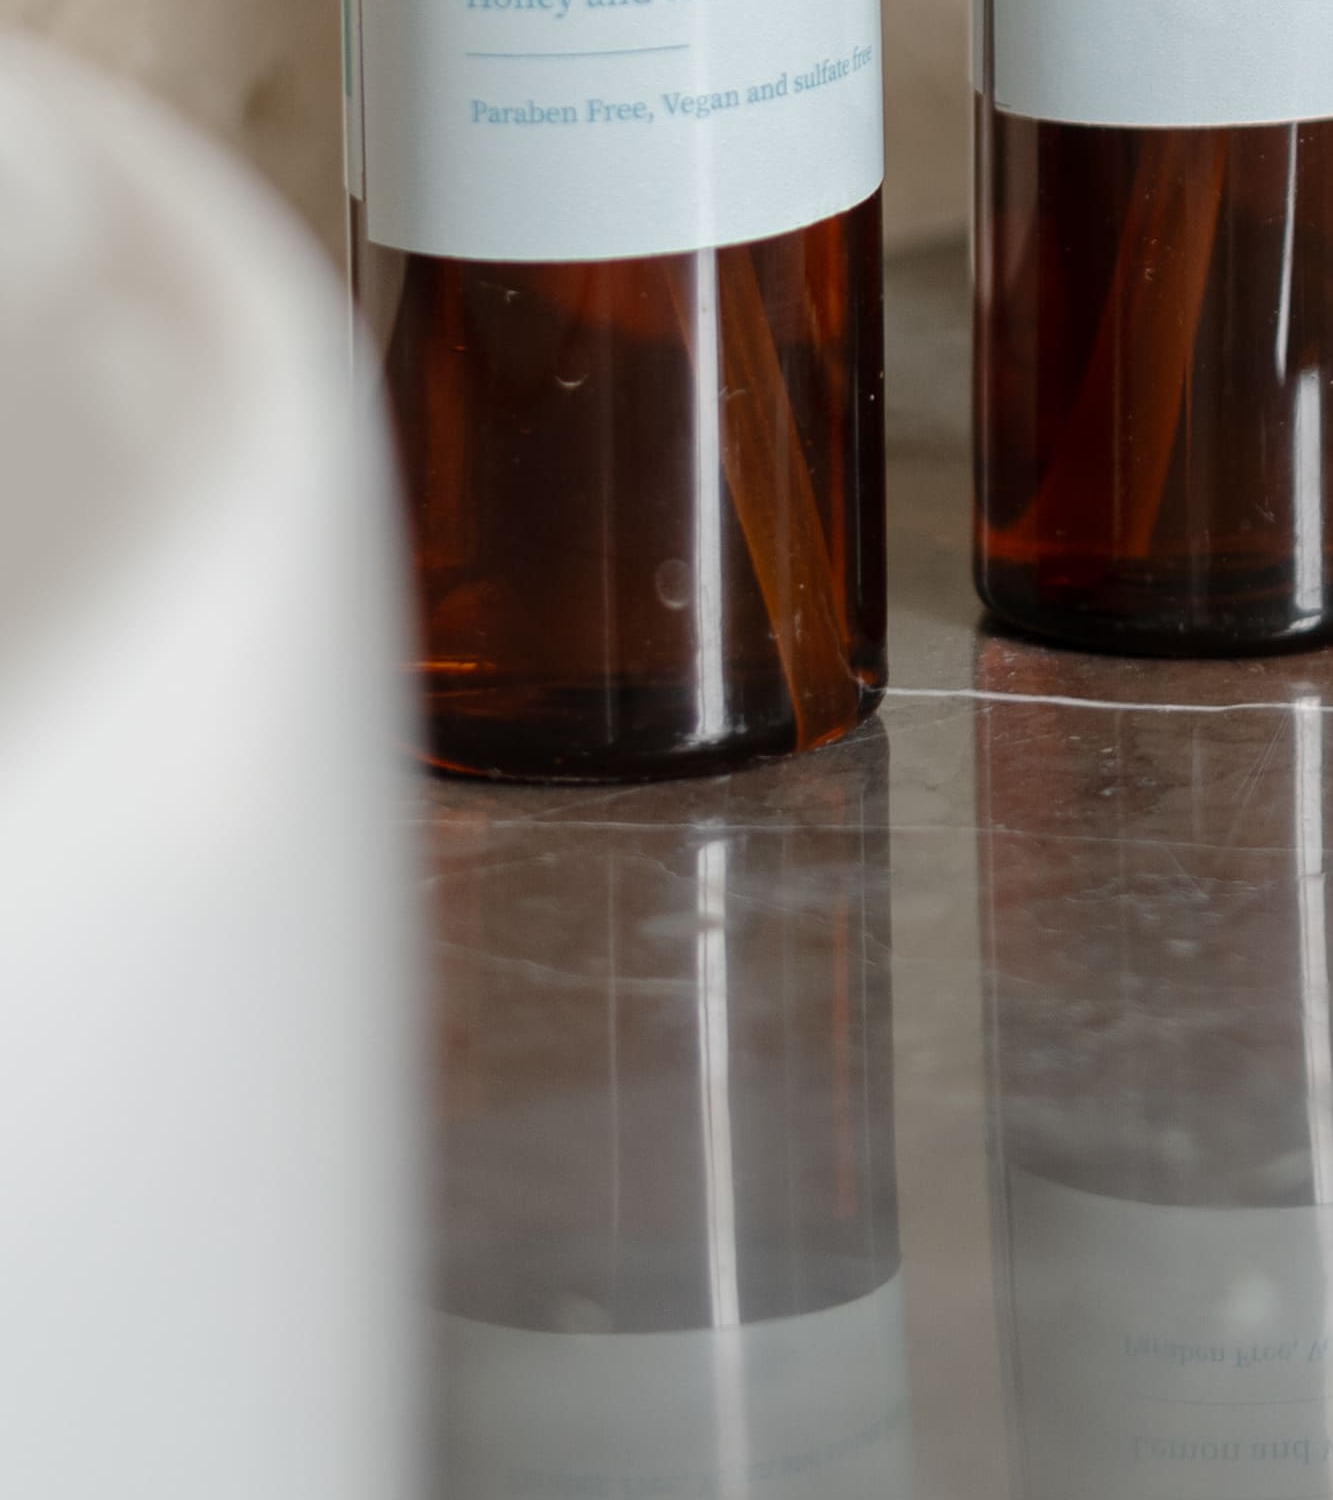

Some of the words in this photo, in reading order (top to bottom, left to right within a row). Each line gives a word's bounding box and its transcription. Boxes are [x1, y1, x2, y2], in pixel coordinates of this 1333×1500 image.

[471, 99, 577, 126] Paraben
[586, 98, 654, 125] Free,
[661, 89, 740, 120] Vegan
[747, 72, 789, 104] and
[793, 56, 851, 92] sulfate
[852, 44, 874, 73] free
